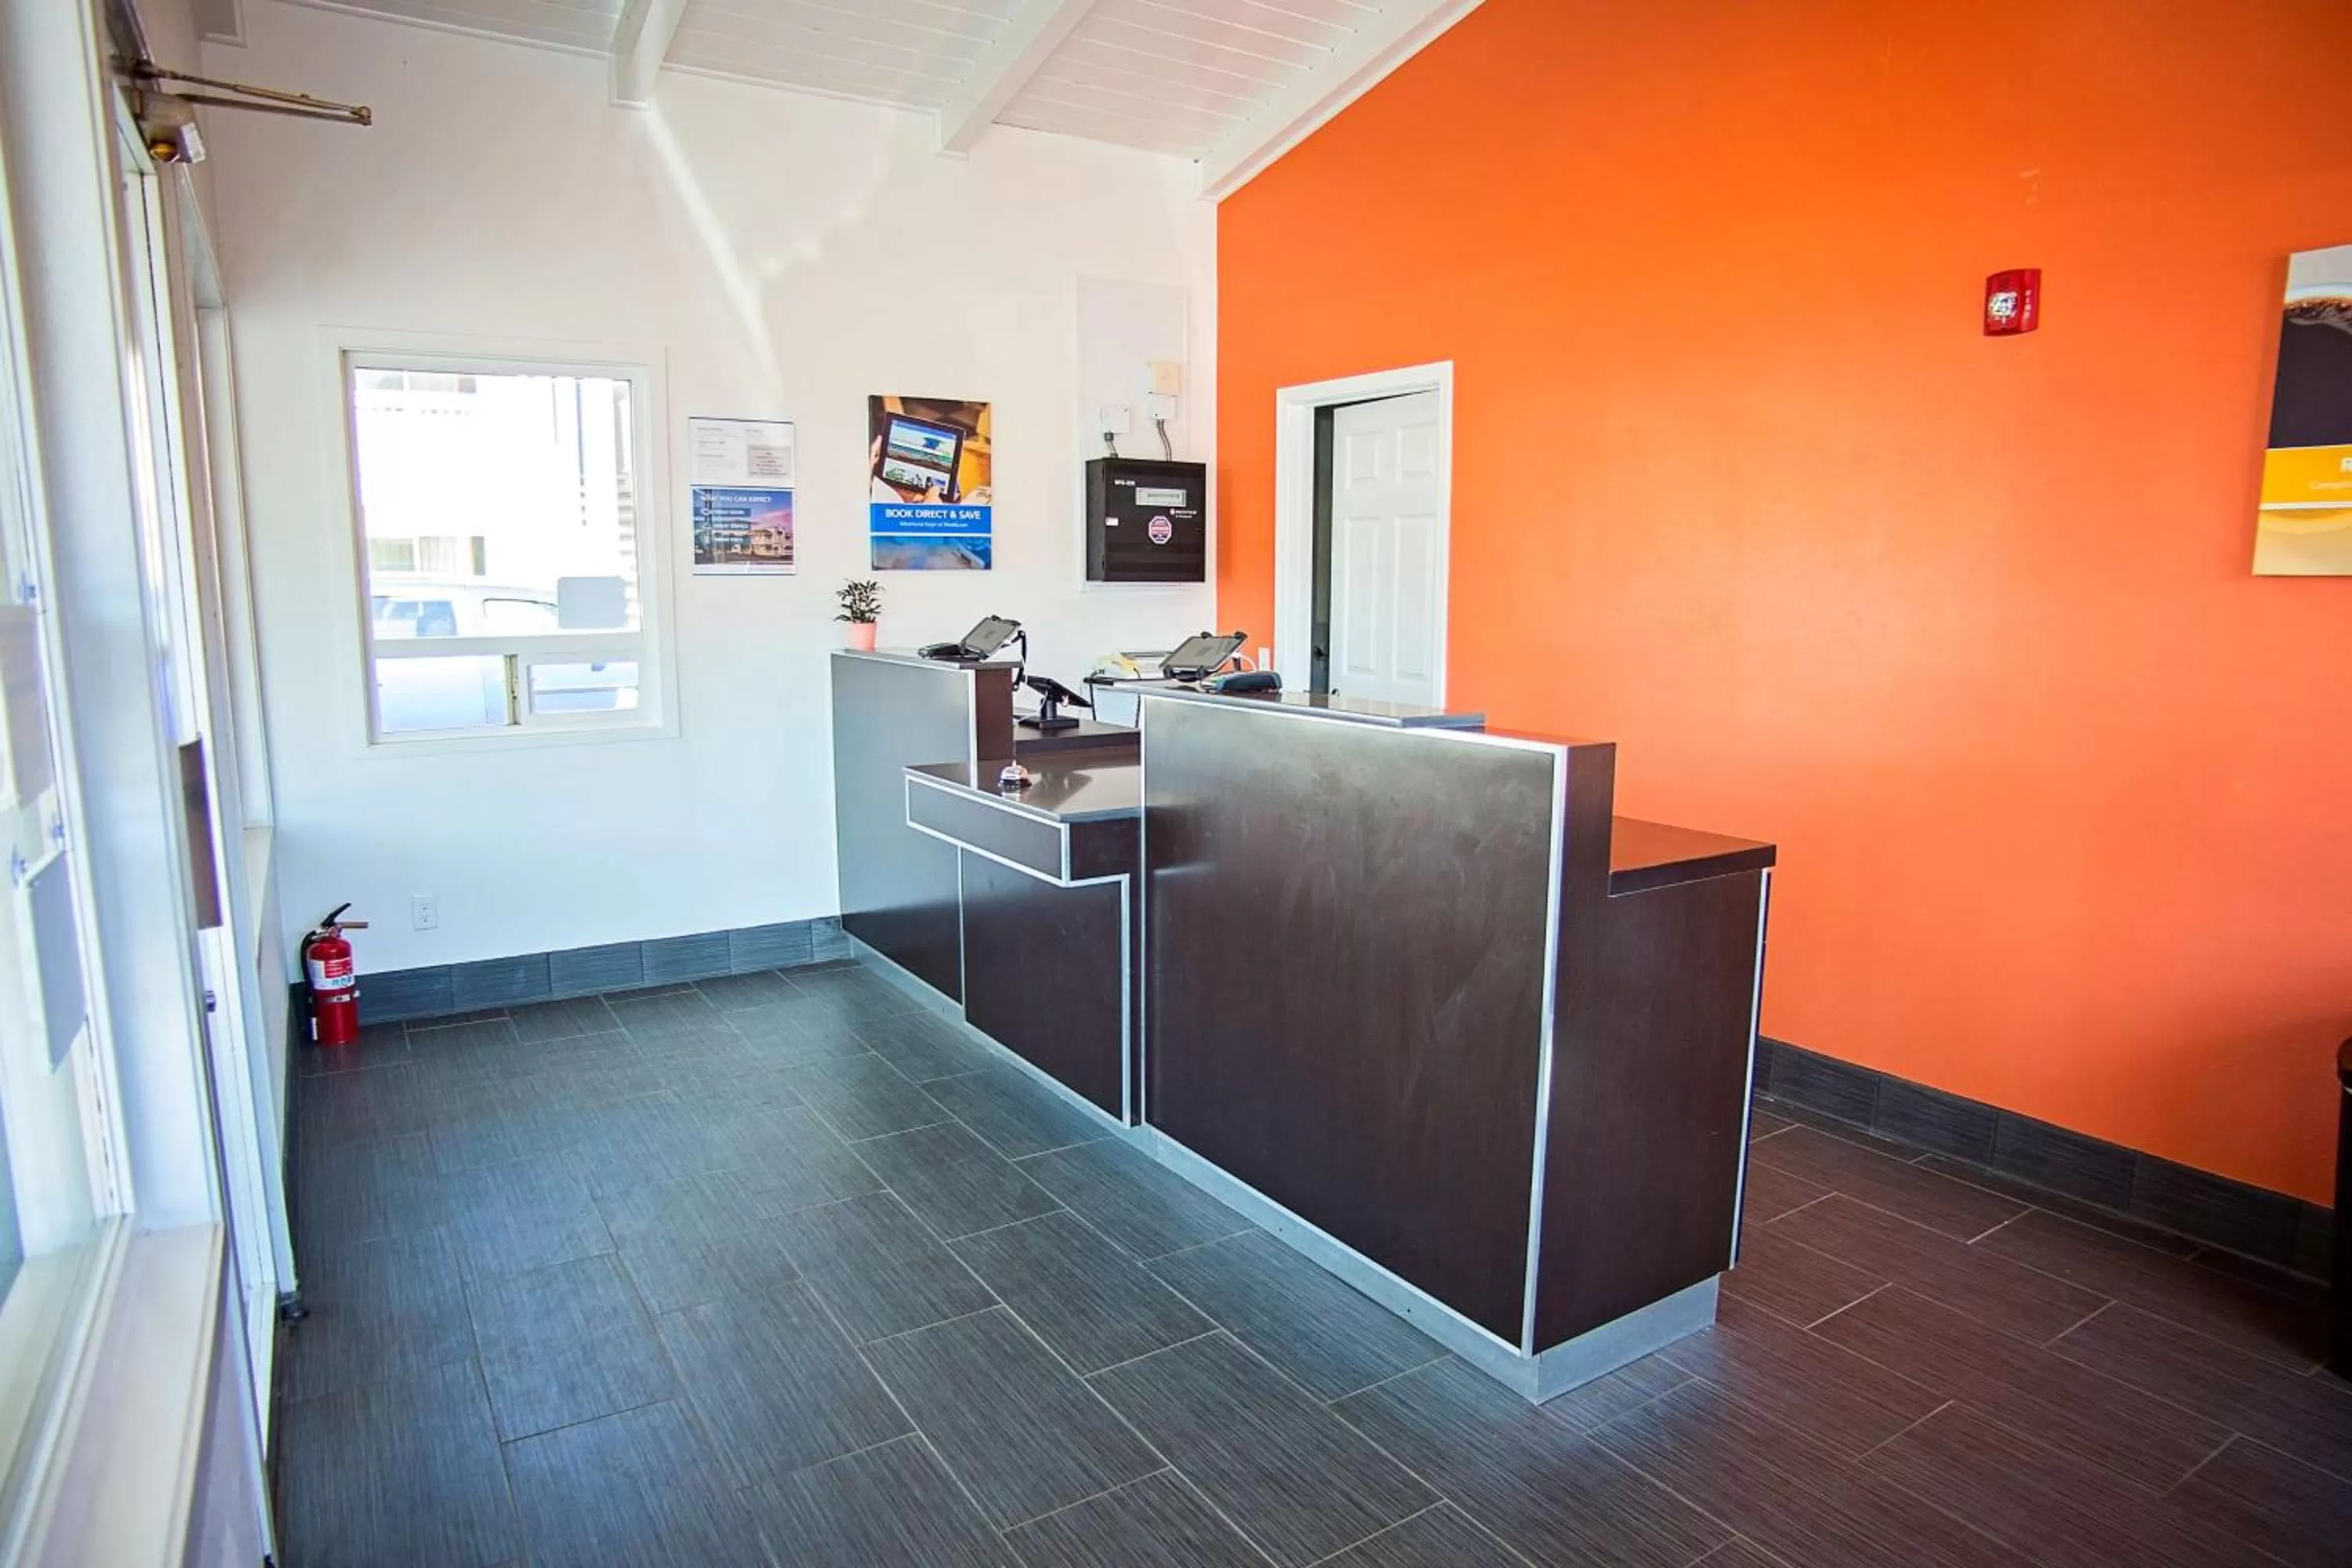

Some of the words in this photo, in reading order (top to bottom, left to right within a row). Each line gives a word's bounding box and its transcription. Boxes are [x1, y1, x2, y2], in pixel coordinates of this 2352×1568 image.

[885, 509, 913, 518] BOOK
[915, 510, 947, 519] DIRECT
[949, 510, 957, 519] &
[959, 510, 982, 520] SAVE
